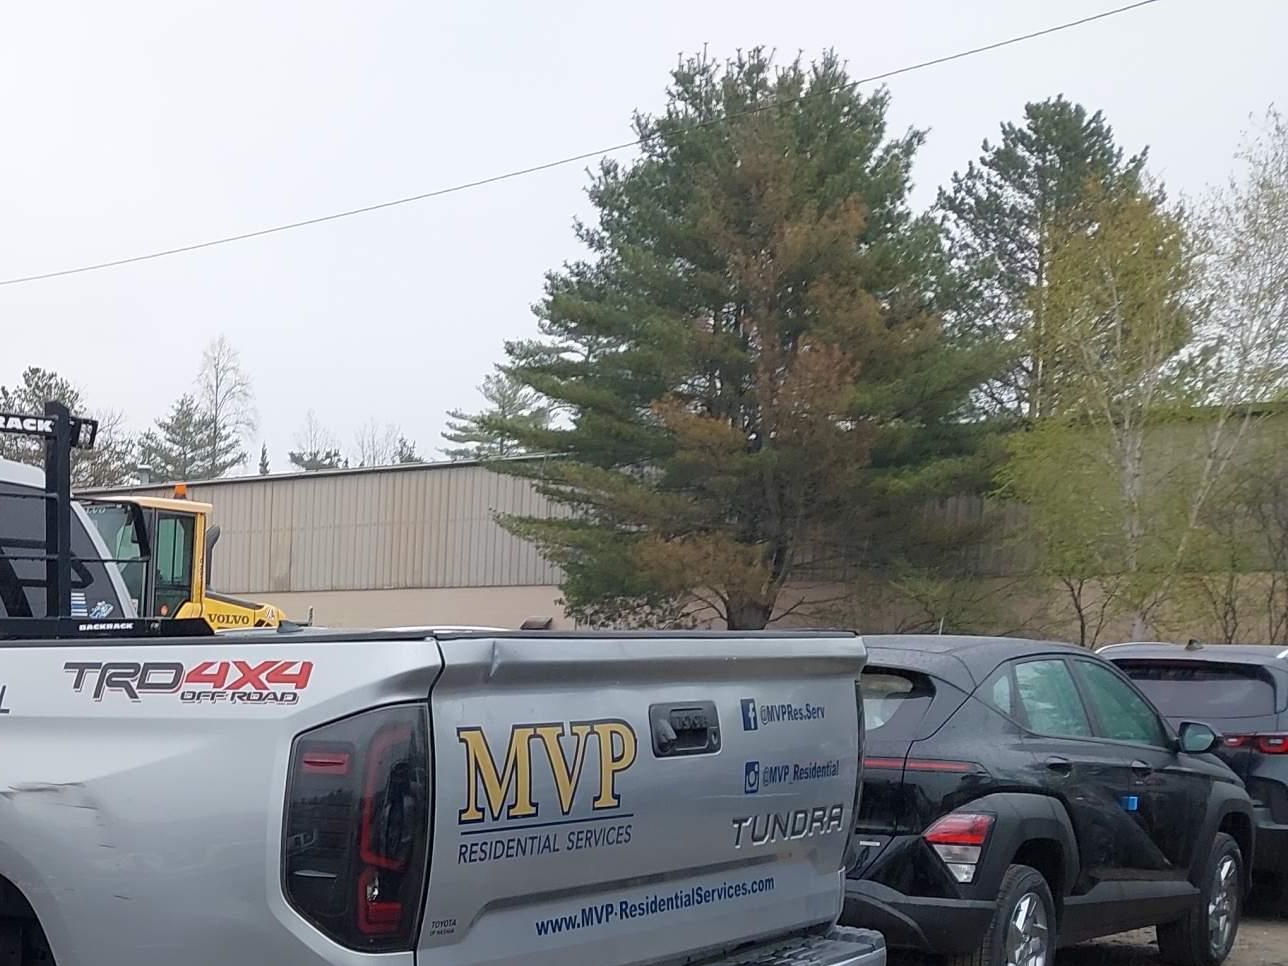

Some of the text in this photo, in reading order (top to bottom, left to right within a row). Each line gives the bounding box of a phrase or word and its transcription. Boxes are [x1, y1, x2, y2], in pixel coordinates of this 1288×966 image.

[79, 623, 134, 631] BACKRACK
[208, 614, 250, 625] VOLVO
[63, 662, 185, 702] TRD
[180, 690, 300, 705] OFF ROAD
[457, 718, 638, 825] MVP
[763, 760, 840, 787] @MVP_Residential
[732, 803, 844, 848] TUNDRA
[458, 824, 633, 864] RESIDENTIAL SERVICES
[431, 919, 457, 929] TOYOTA
